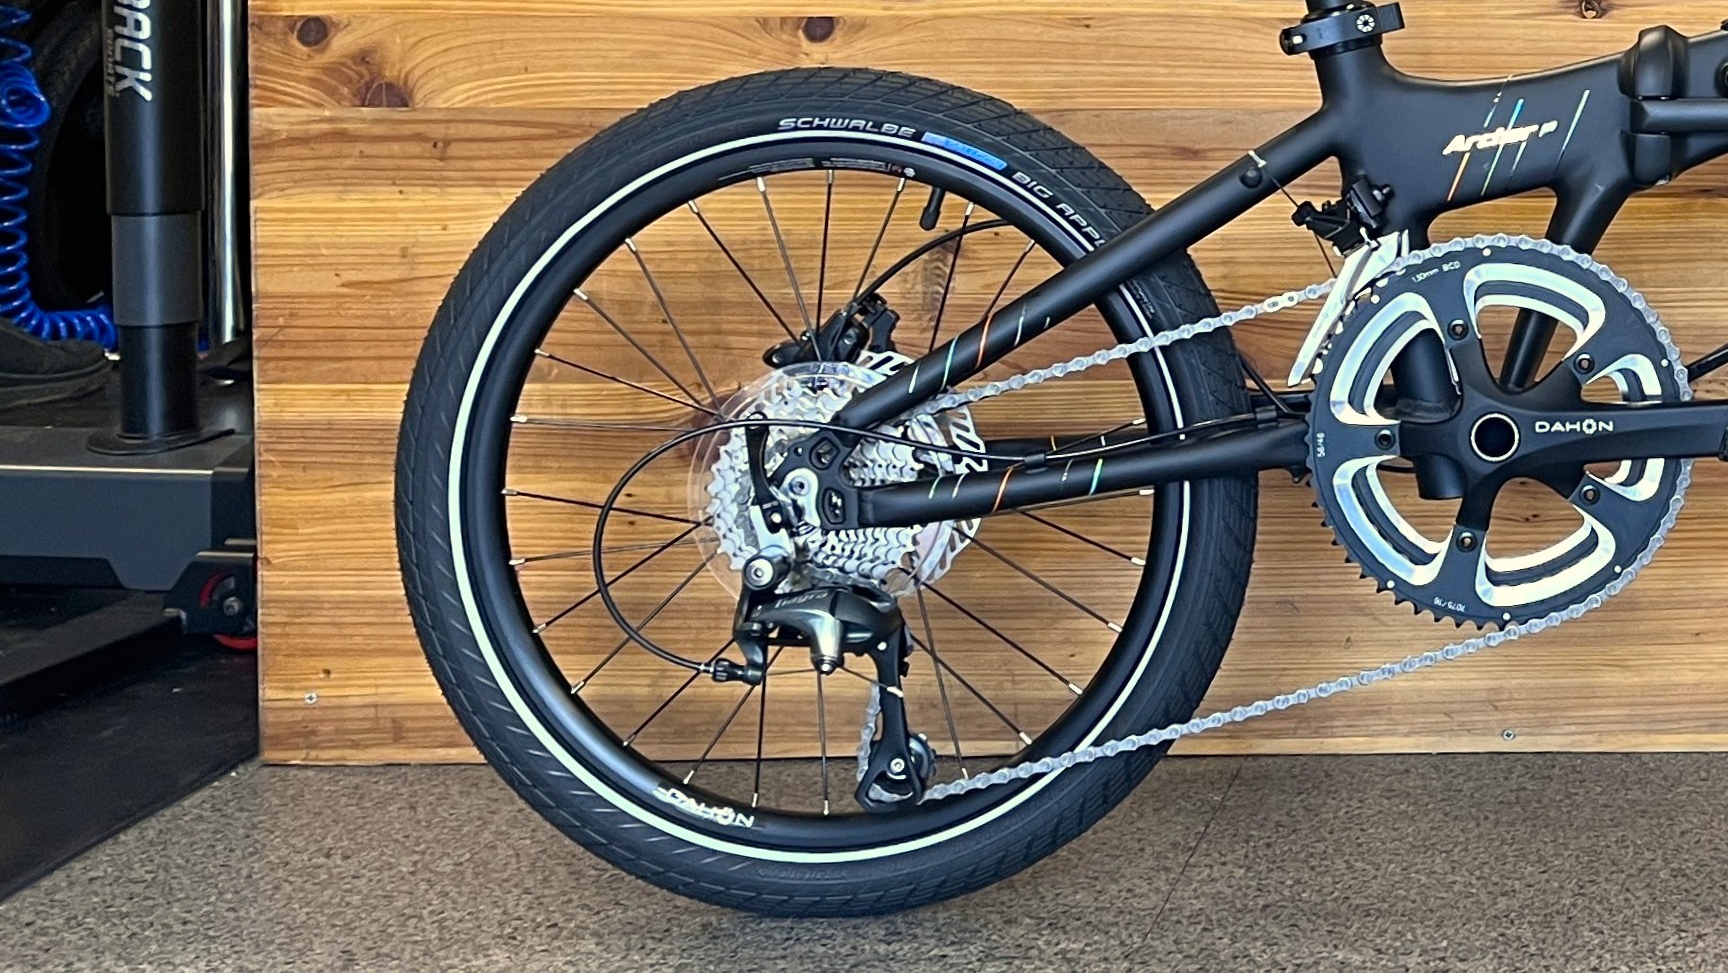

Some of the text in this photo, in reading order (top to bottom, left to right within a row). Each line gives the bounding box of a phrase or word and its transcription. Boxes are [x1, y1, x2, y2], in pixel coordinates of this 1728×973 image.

[777, 116, 916, 138] SCHWALBE
[1011, 170, 1106, 248] BIG APPL
[1534, 418, 1614, 435] DAHON
[666, 787, 755, 828] DAHON
